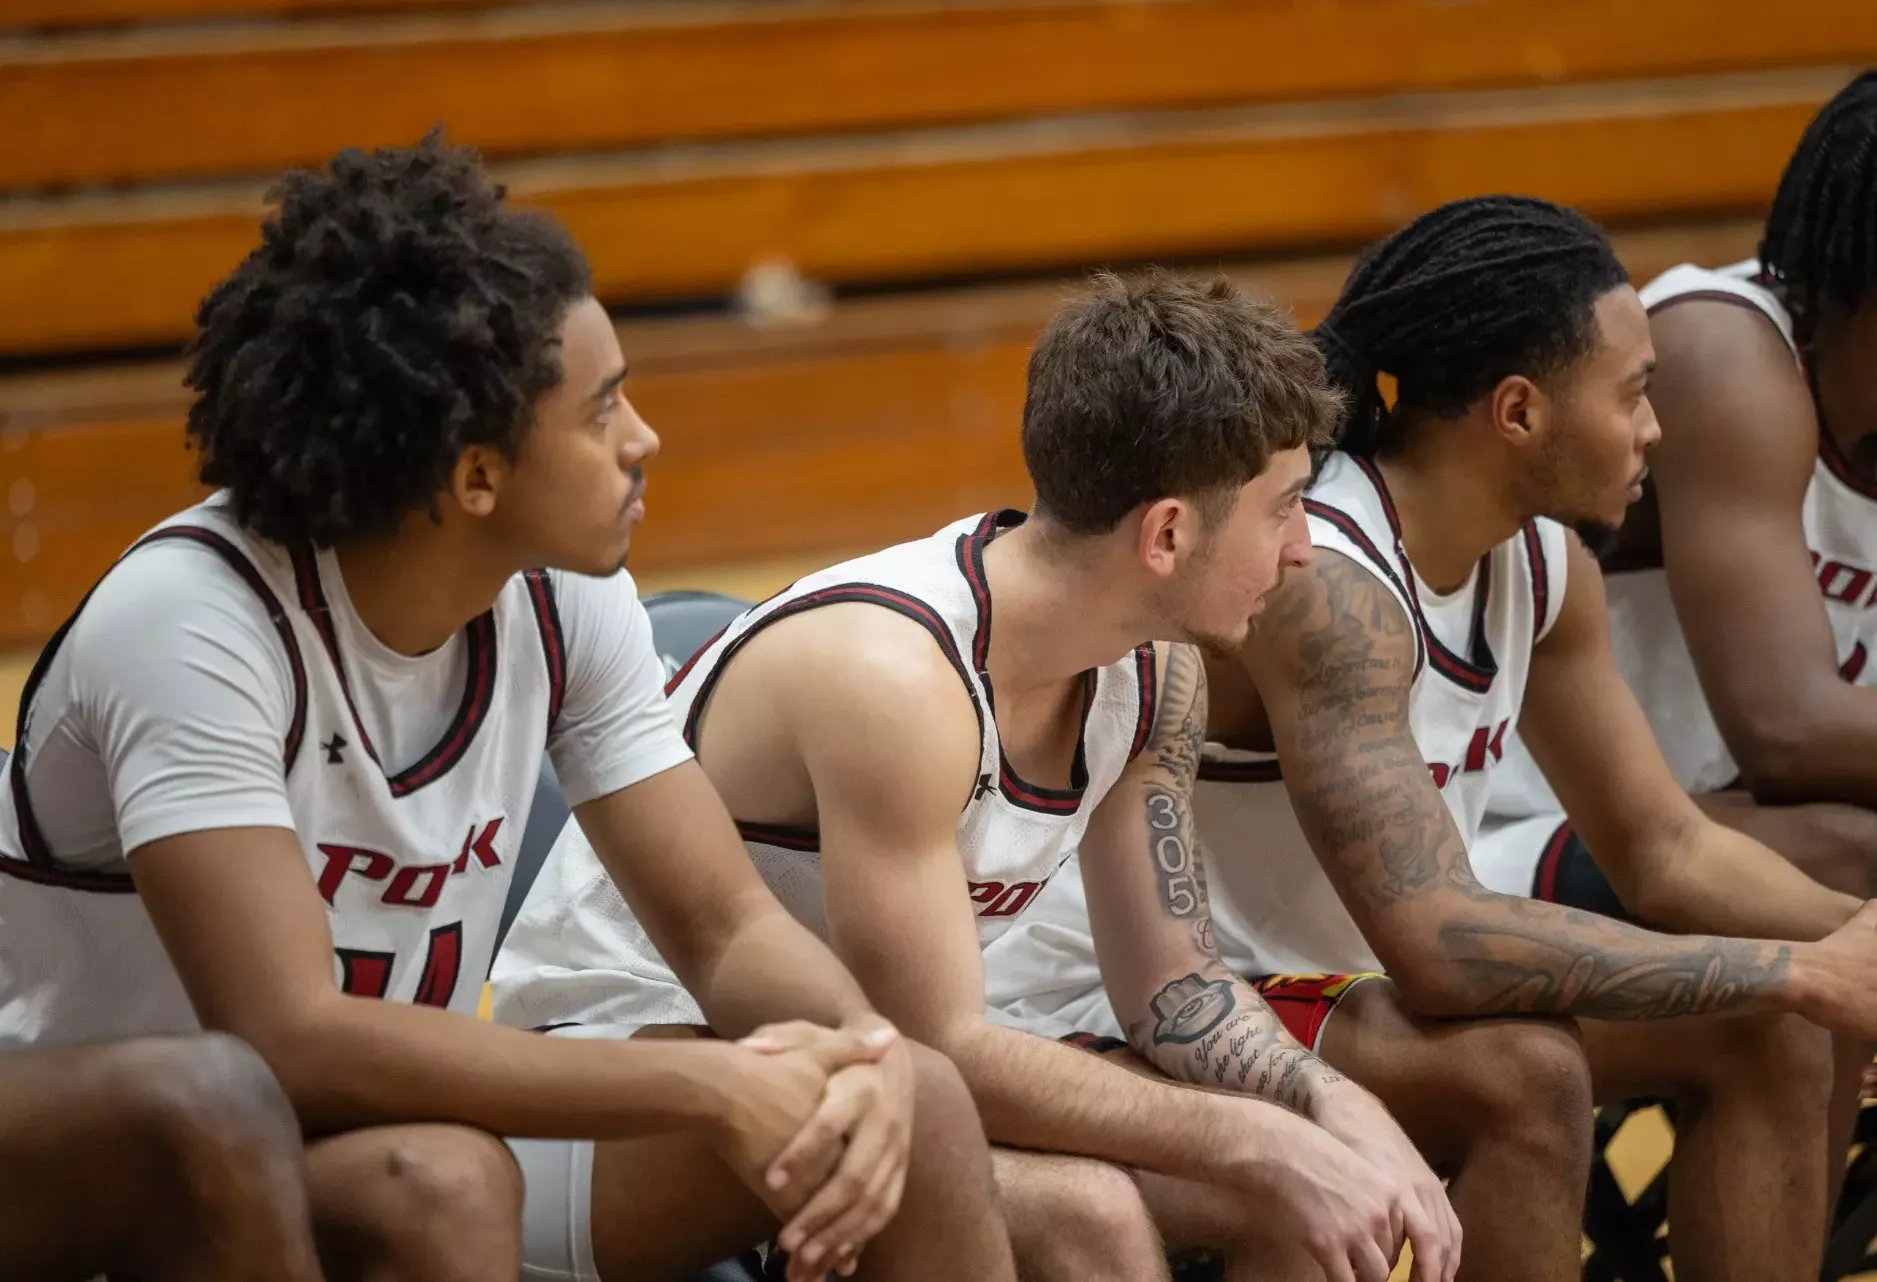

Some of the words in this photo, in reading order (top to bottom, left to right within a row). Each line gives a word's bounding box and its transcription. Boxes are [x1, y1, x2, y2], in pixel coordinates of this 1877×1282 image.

[316, 816, 505, 908] POK
[1147, 794, 1196, 916] 305
[967, 879, 1048, 917] PO
[1194, 1028, 1223, 1072] You
[1225, 1014, 1251, 1032] are
[1214, 1050, 1231, 1083] the
[1229, 1023, 1263, 1058] light
